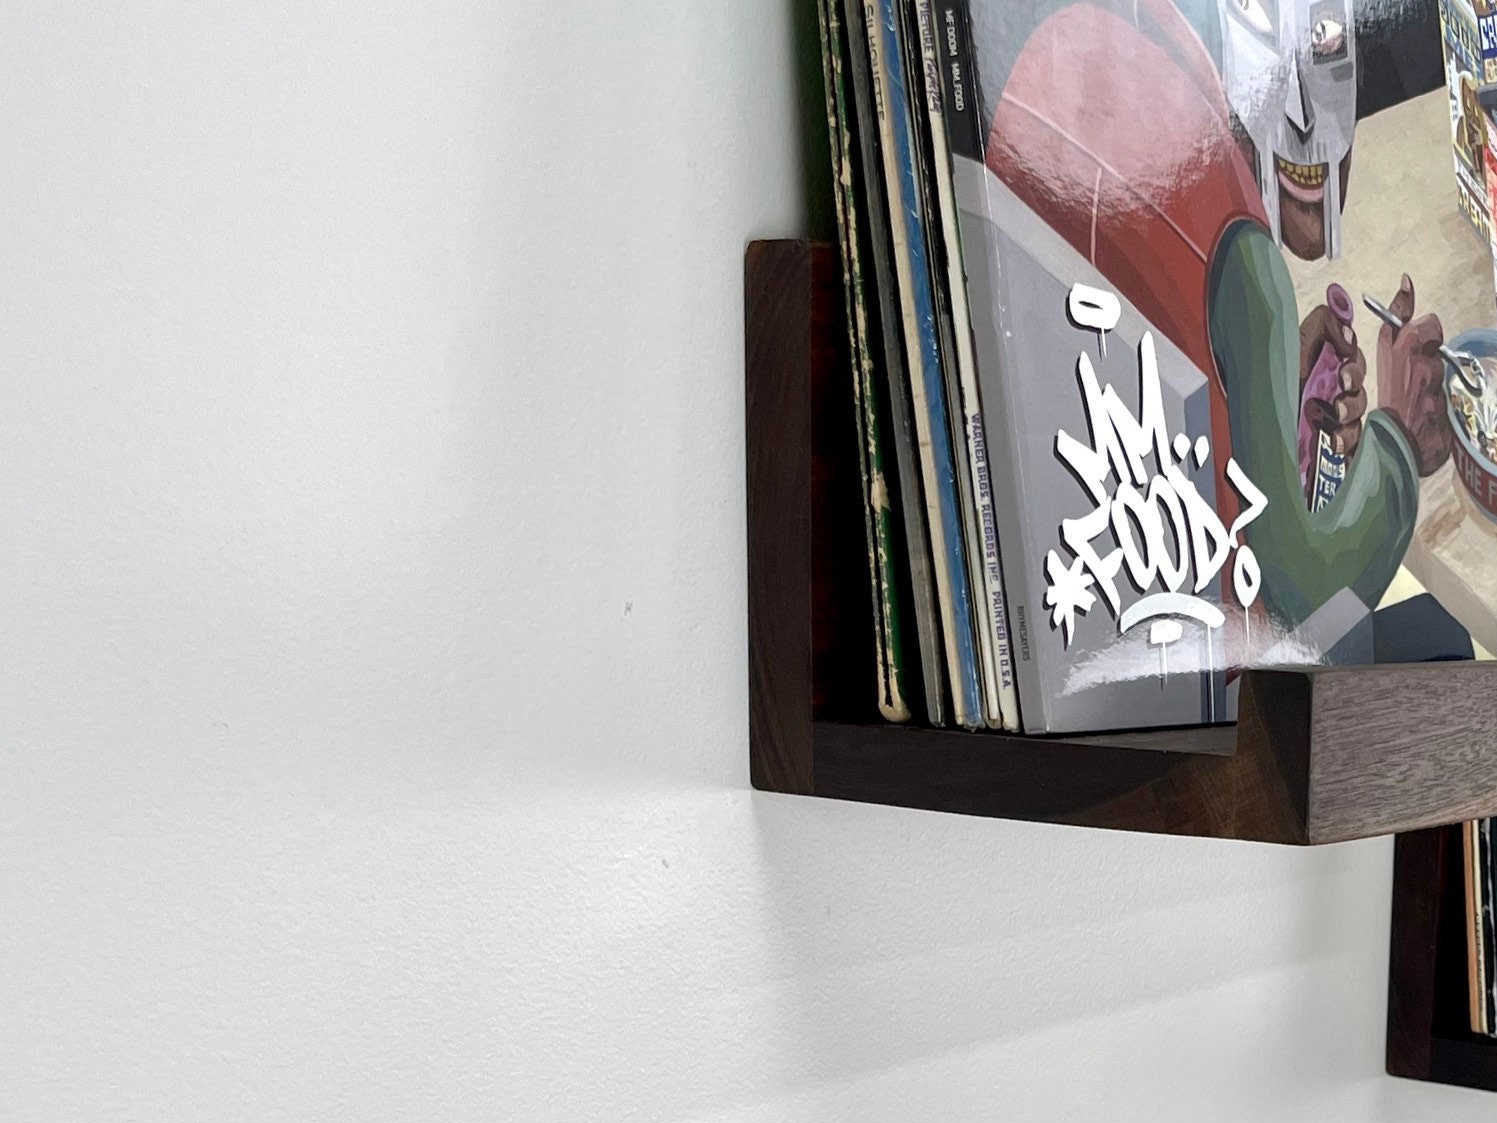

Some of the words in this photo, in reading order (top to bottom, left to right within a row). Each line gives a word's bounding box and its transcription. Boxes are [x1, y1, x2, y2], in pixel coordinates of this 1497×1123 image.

[947, 26, 958, 57] DOOM
[1455, 442, 1482, 497] THE
[972, 413, 985, 463] WARNER
[982, 504, 997, 559] RECORDS
[992, 591, 1006, 640] PRINTED
[999, 644, 1009, 656] IN
[1017, 605, 1030, 662] RHYMESAYERS
